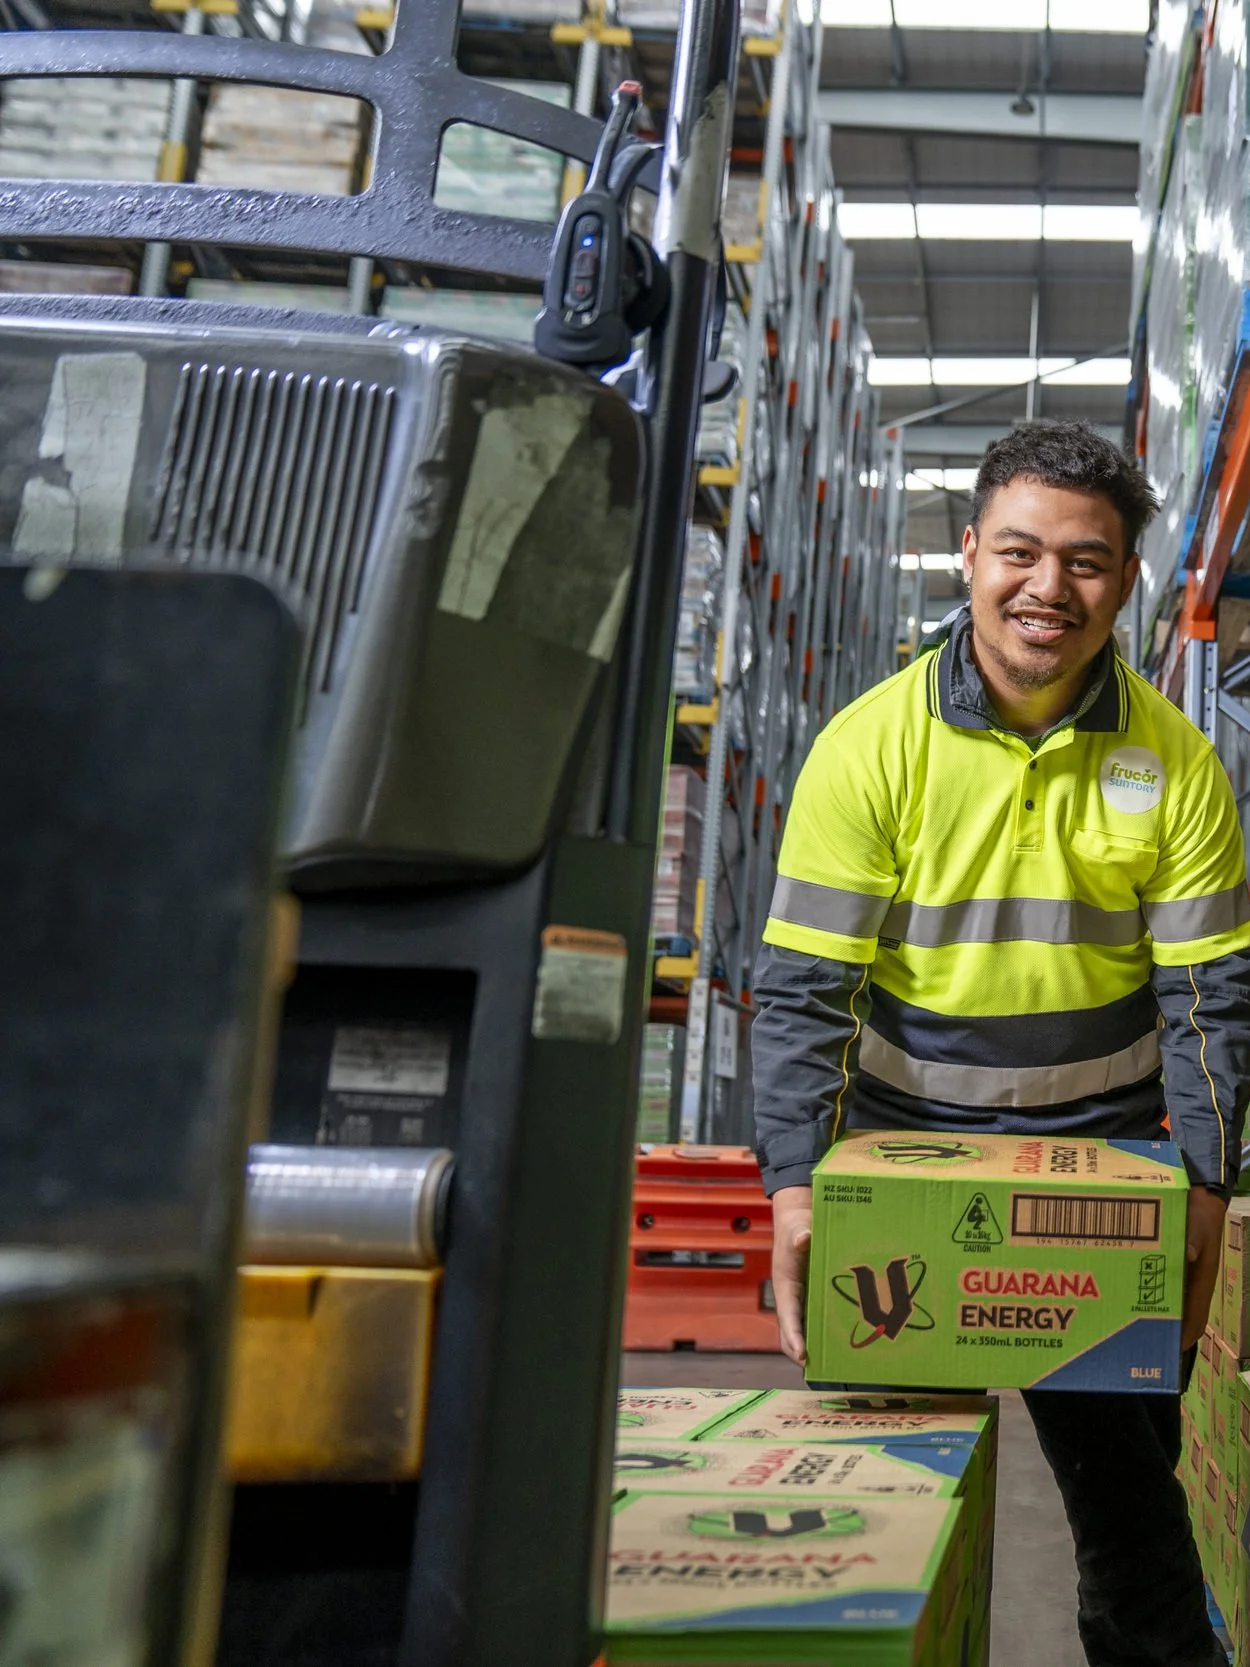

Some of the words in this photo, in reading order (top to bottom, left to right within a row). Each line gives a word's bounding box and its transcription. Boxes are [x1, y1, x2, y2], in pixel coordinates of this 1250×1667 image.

[1110, 762, 1158, 785] frucor
[1012, 1141, 1045, 1174] GUARANA
[1050, 1144, 1079, 1174] ENERGY
[823, 1184, 835, 1192] NZ
[836, 1184, 855, 1193] SKU:
[836, 1194, 855, 1202] SKU:
[963, 1243, 991, 1253] CAUTION
[962, 1269, 1099, 1298] GUARANA
[960, 1304, 1075, 1331] ENERGY
[955, 1335, 968, 1346] 24
[970, 1338, 977, 1346] x
[979, 1336, 1012, 1347] 350mL
[1015, 1337, 1063, 1349] BOTTLES
[1130, 1367, 1162, 1379] BLUE
[782, 1419, 930, 1427] ENERGY
[609, 1550, 877, 1566] GUARANA
[614, 1563, 850, 1580] ENERGY
